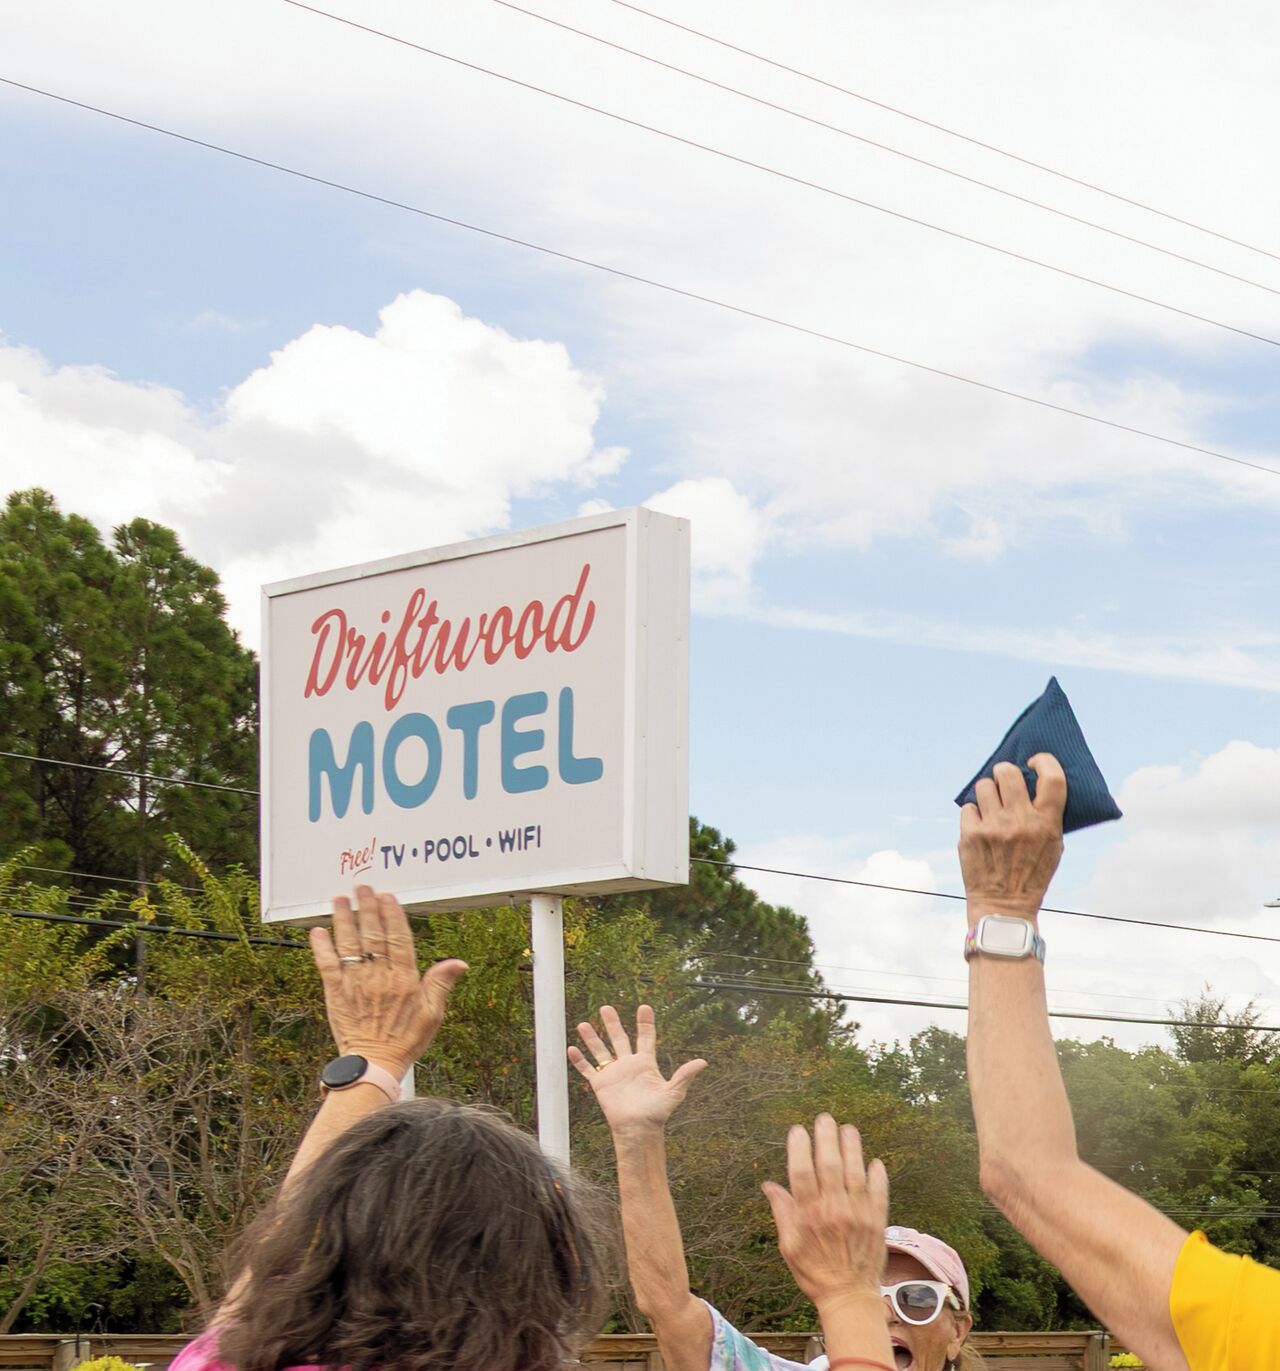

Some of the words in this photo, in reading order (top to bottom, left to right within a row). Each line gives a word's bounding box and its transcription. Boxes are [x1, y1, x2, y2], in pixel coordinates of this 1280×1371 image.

[304, 563, 596, 711] Driftwood
[308, 686, 604, 822] MOTEL
[380, 843, 405, 869] TV
[424, 834, 480, 863] POOL
[498, 825, 541, 853] WIFI
